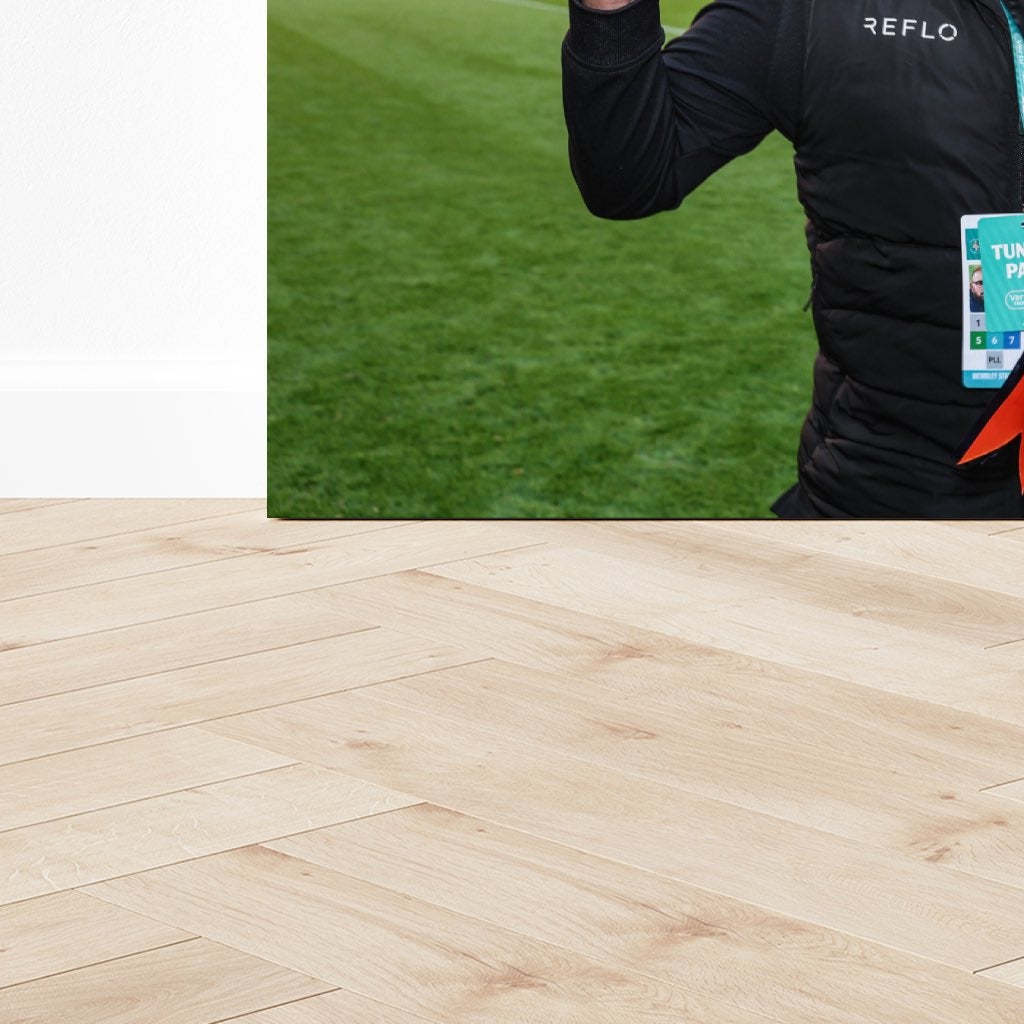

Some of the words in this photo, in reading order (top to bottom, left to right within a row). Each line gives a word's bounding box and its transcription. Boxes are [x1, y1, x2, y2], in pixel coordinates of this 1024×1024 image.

[863, 17, 957, 41] REFLO
[976, 319, 980, 327] 1
[975, 336, 982, 345] 5
[991, 336, 998, 345] 6
[1008, 336, 1015, 345] 7
